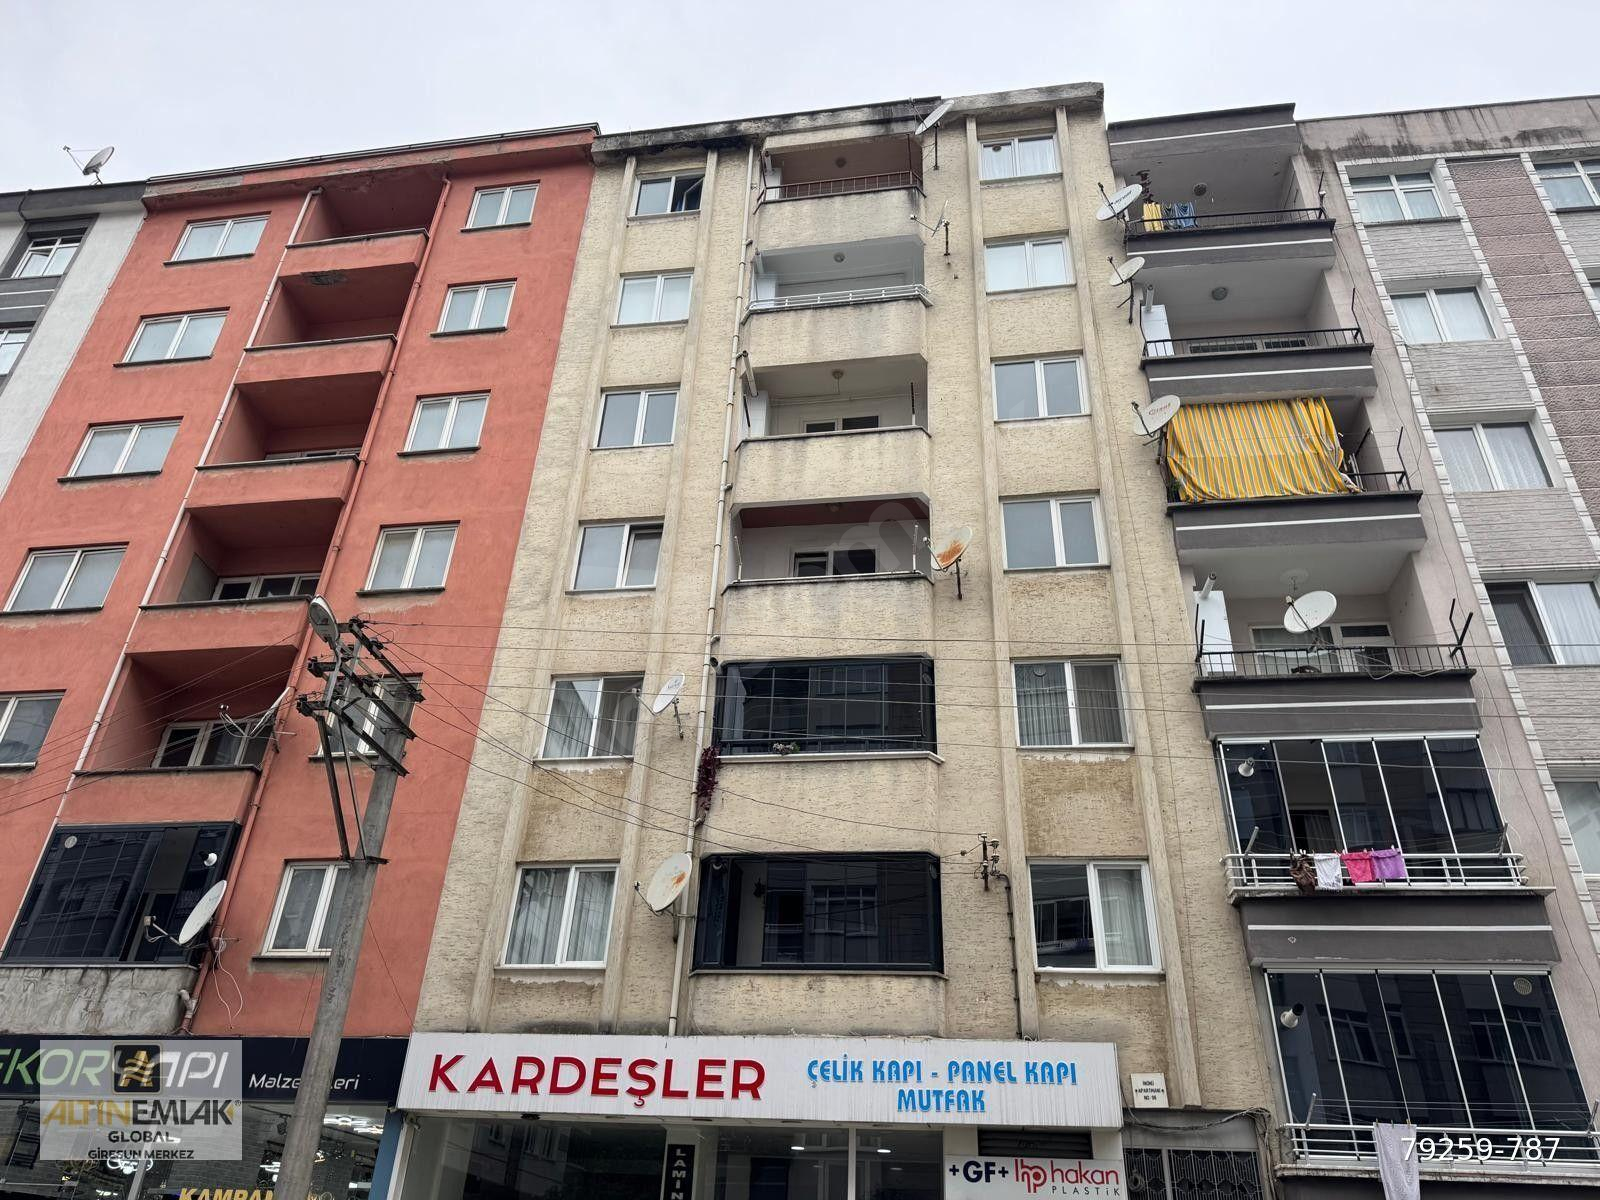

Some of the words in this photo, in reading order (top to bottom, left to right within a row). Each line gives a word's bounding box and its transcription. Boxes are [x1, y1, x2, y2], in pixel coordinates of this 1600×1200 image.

[428, 1053, 766, 1108] KARDEŞLER
[807, 1053, 864, 1089] ÇELİK
[872, 1060, 923, 1083] KAPI
[947, 1060, 1018, 1084] PANEL
[1025, 1061, 1078, 1086] KAPI
[897, 1089, 986, 1113] MUTFAK
[1051, 1160, 1120, 1185] hakan
